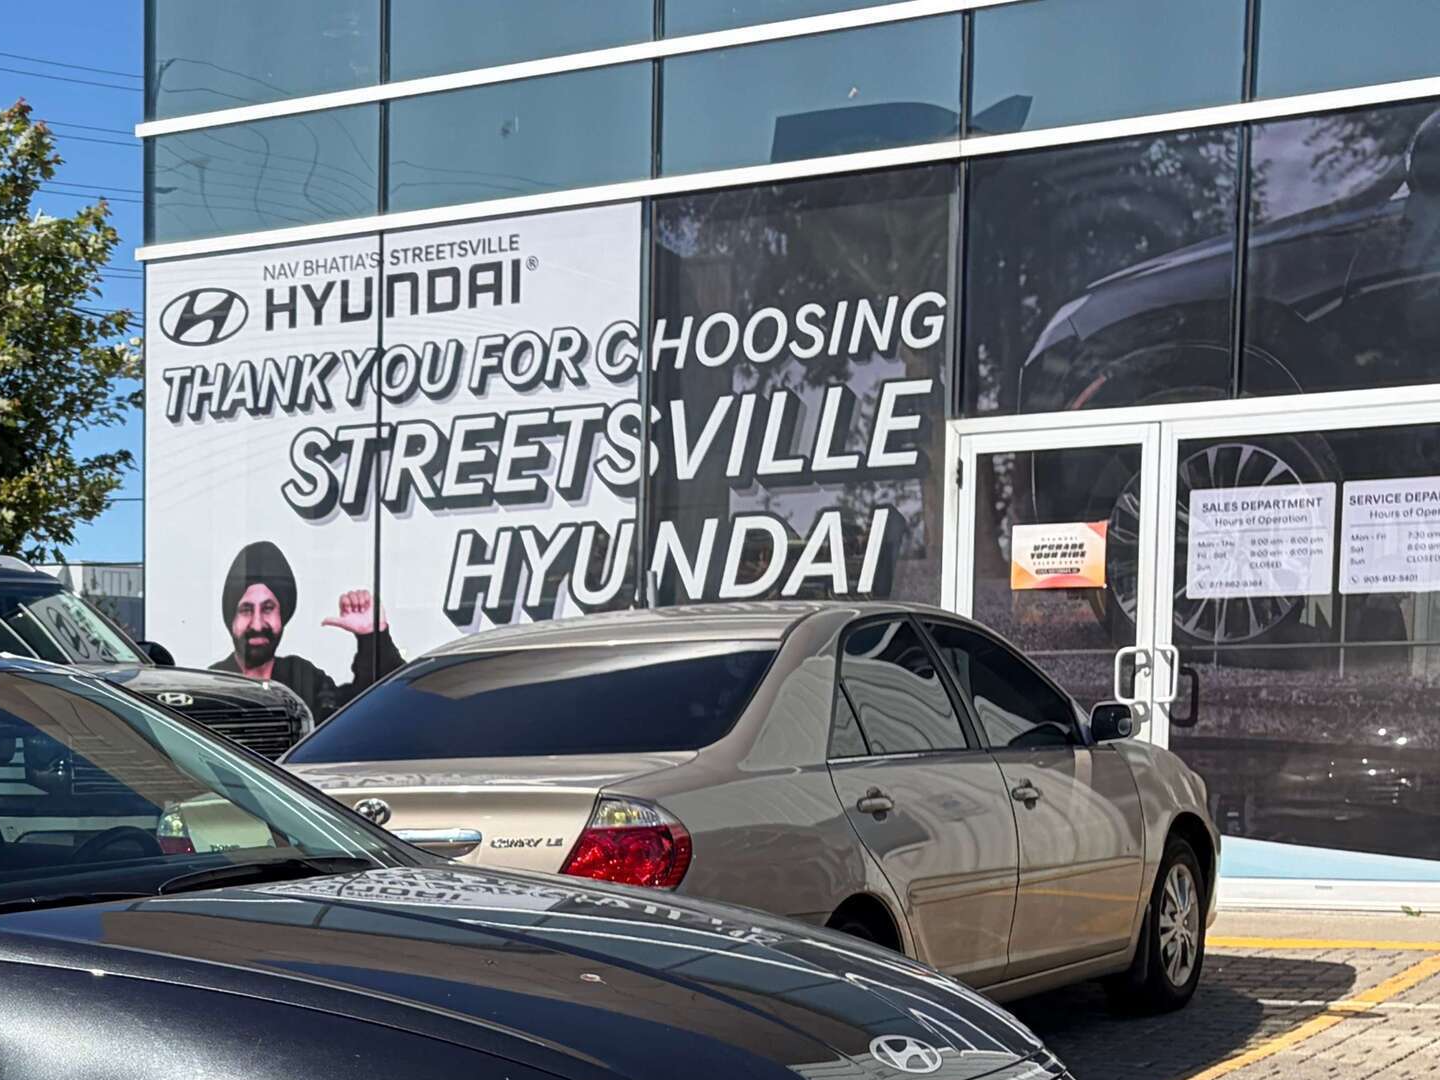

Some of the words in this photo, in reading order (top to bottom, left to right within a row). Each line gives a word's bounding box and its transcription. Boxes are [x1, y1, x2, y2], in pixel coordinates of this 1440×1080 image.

[262, 262, 300, 281] NAV
[303, 252, 383, 276] BHATIA'S
[389, 234, 520, 266] STREETSVILLE
[162, 352, 340, 423] THANK
[342, 339, 463, 406] YOU
[468, 327, 590, 397] FOR
[595, 291, 948, 383] CHOOSING
[281, 378, 936, 518] STREETSVILLE
[1202, 501, 1239, 513] SALES
[1241, 497, 1323, 511] DEPARTMENT
[1348, 492, 1402, 506] SERVICE
[1405, 490, 1440, 503] DEPA
[1369, 509, 1400, 519] Hours
[1403, 507, 1413, 517] of
[1215, 517, 1244, 527] Hours
[1246, 516, 1256, 525] of
[1258, 514, 1308, 527] Operation
[443, 507, 895, 625] HYUNDAI
